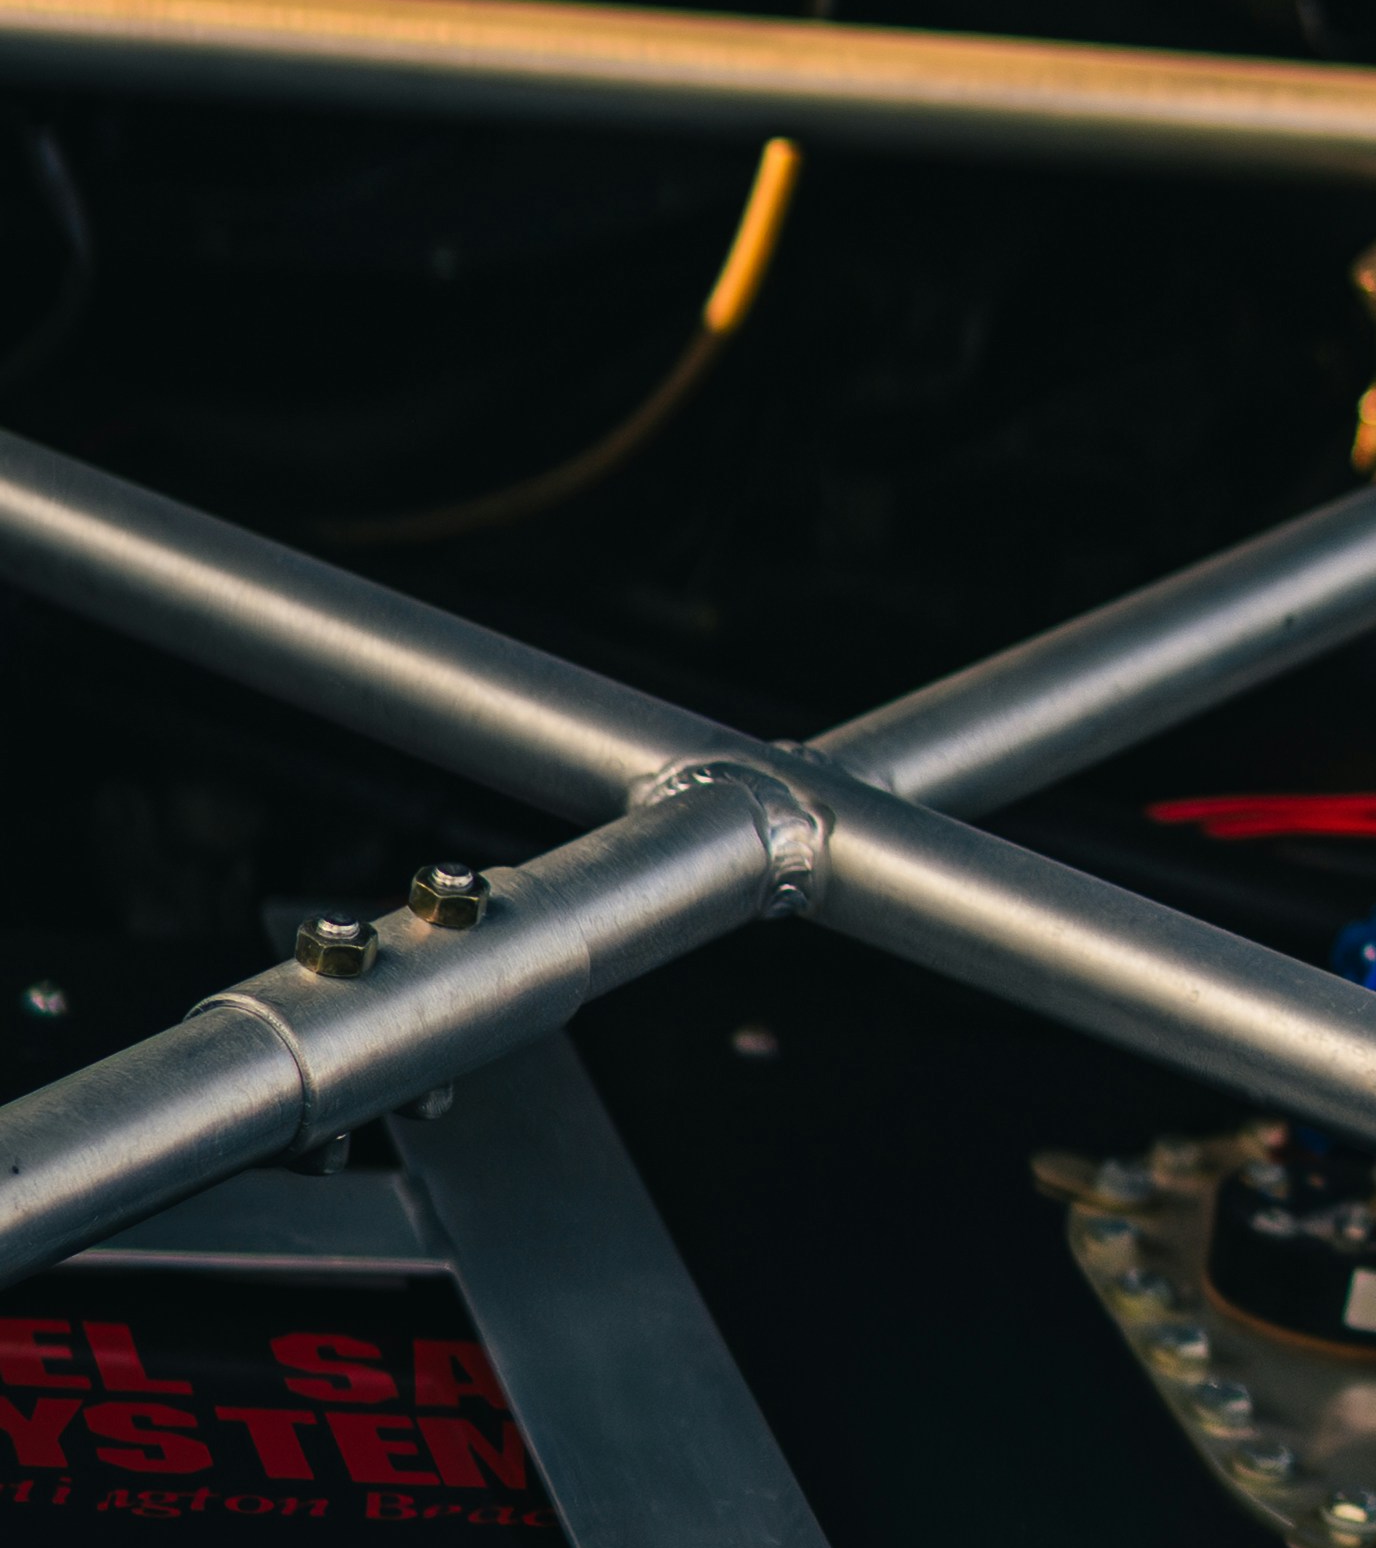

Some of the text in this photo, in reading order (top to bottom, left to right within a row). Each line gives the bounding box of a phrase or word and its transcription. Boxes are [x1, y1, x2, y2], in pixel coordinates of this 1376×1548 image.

[0, 1316, 508, 1409] EL SA
[0, 1476, 329, 1518] tington
